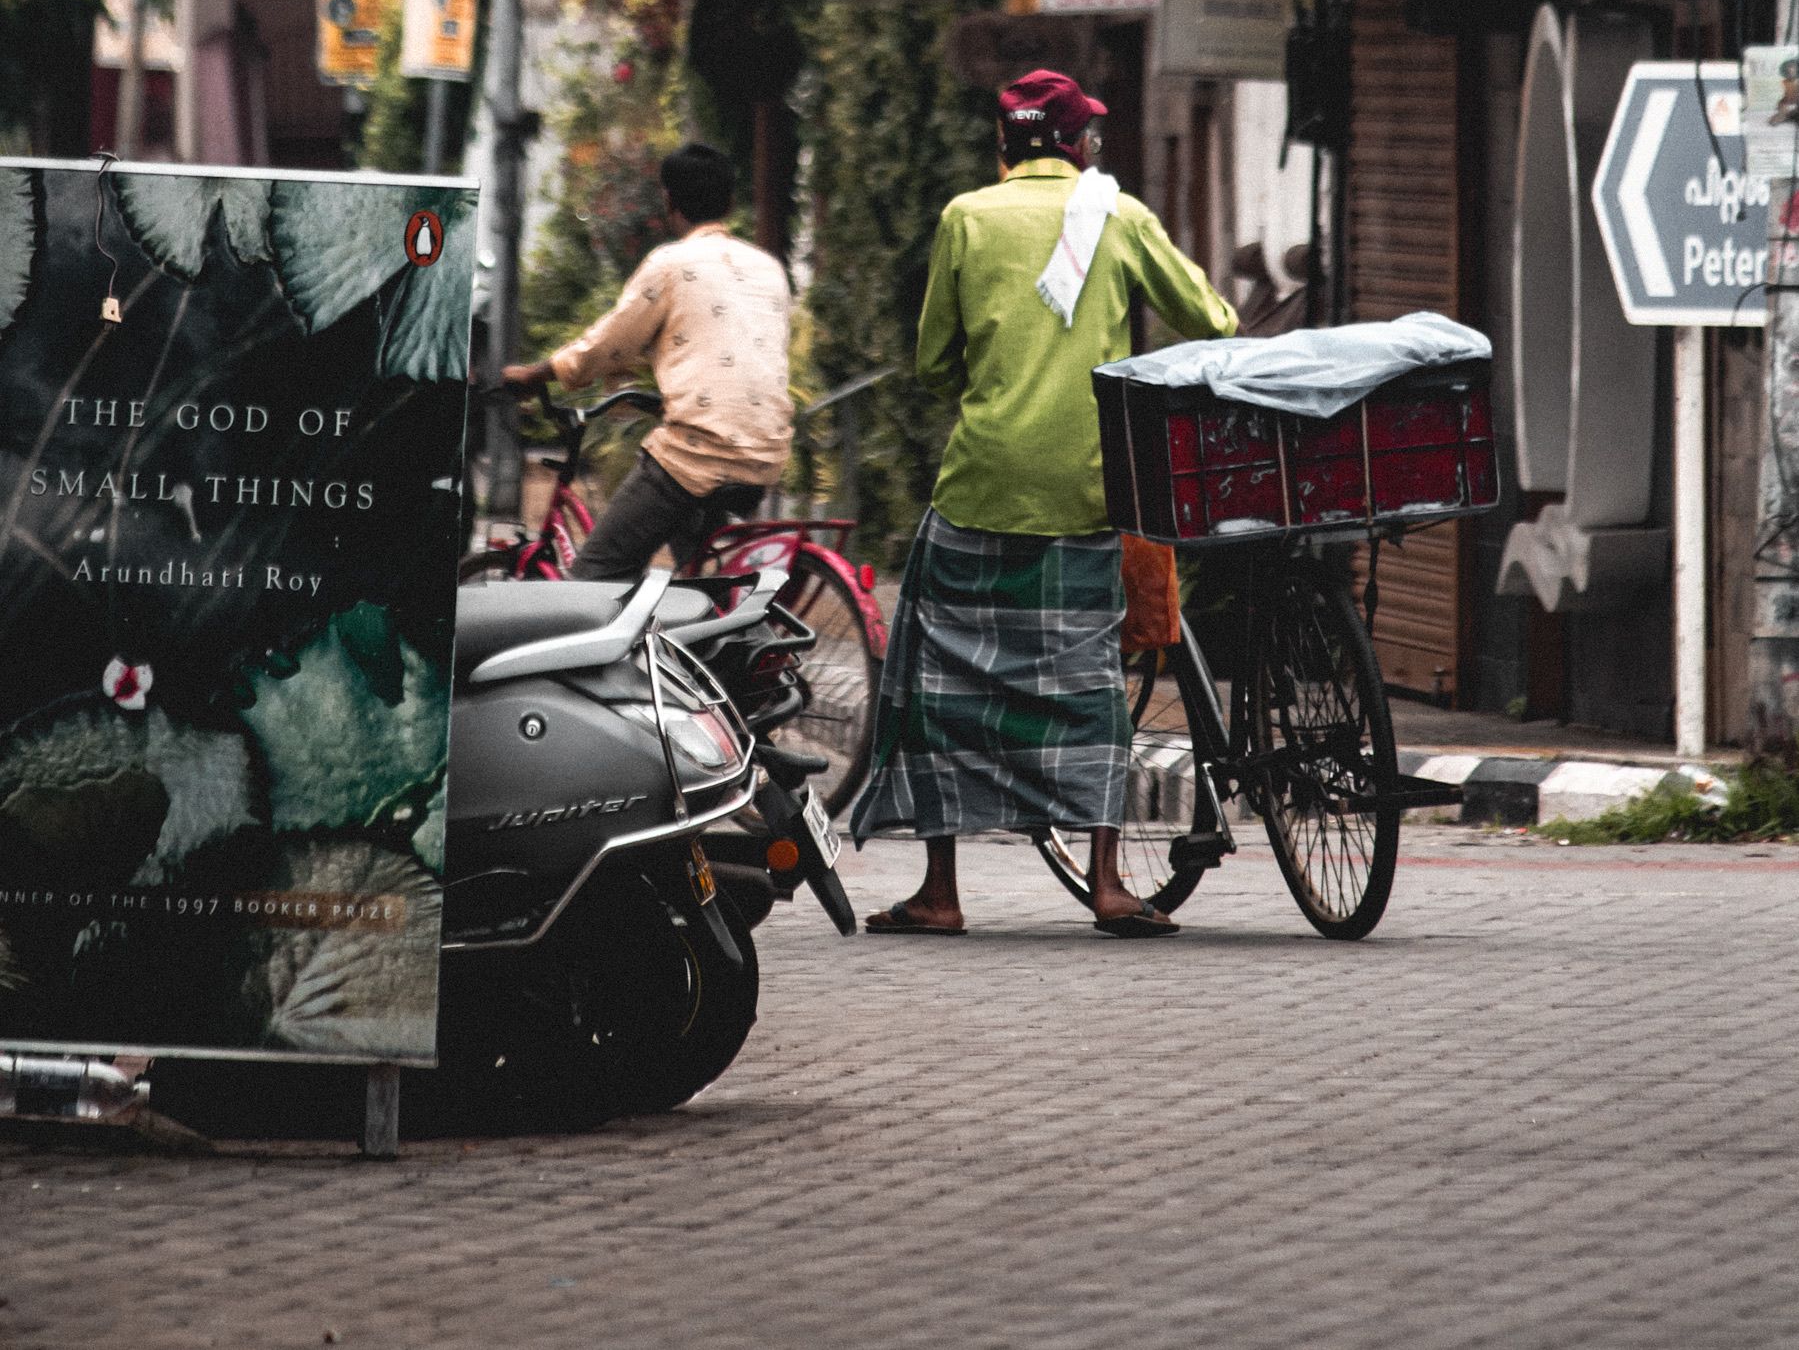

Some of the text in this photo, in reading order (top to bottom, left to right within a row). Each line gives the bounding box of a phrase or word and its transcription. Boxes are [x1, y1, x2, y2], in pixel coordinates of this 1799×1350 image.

[1683, 234, 1768, 287] Peter
[63, 398, 352, 437] THE GOD OF
[30, 469, 375, 510] SMALL THINGS
[72, 559, 323, 596] Arundhati Roy
[69, 892, 94, 907] OF
[110, 894, 148, 909] THE
[164, 896, 220, 916] 1997
[234, 899, 318, 918] BOOKER
[332, 904, 395, 921] PRIZE
